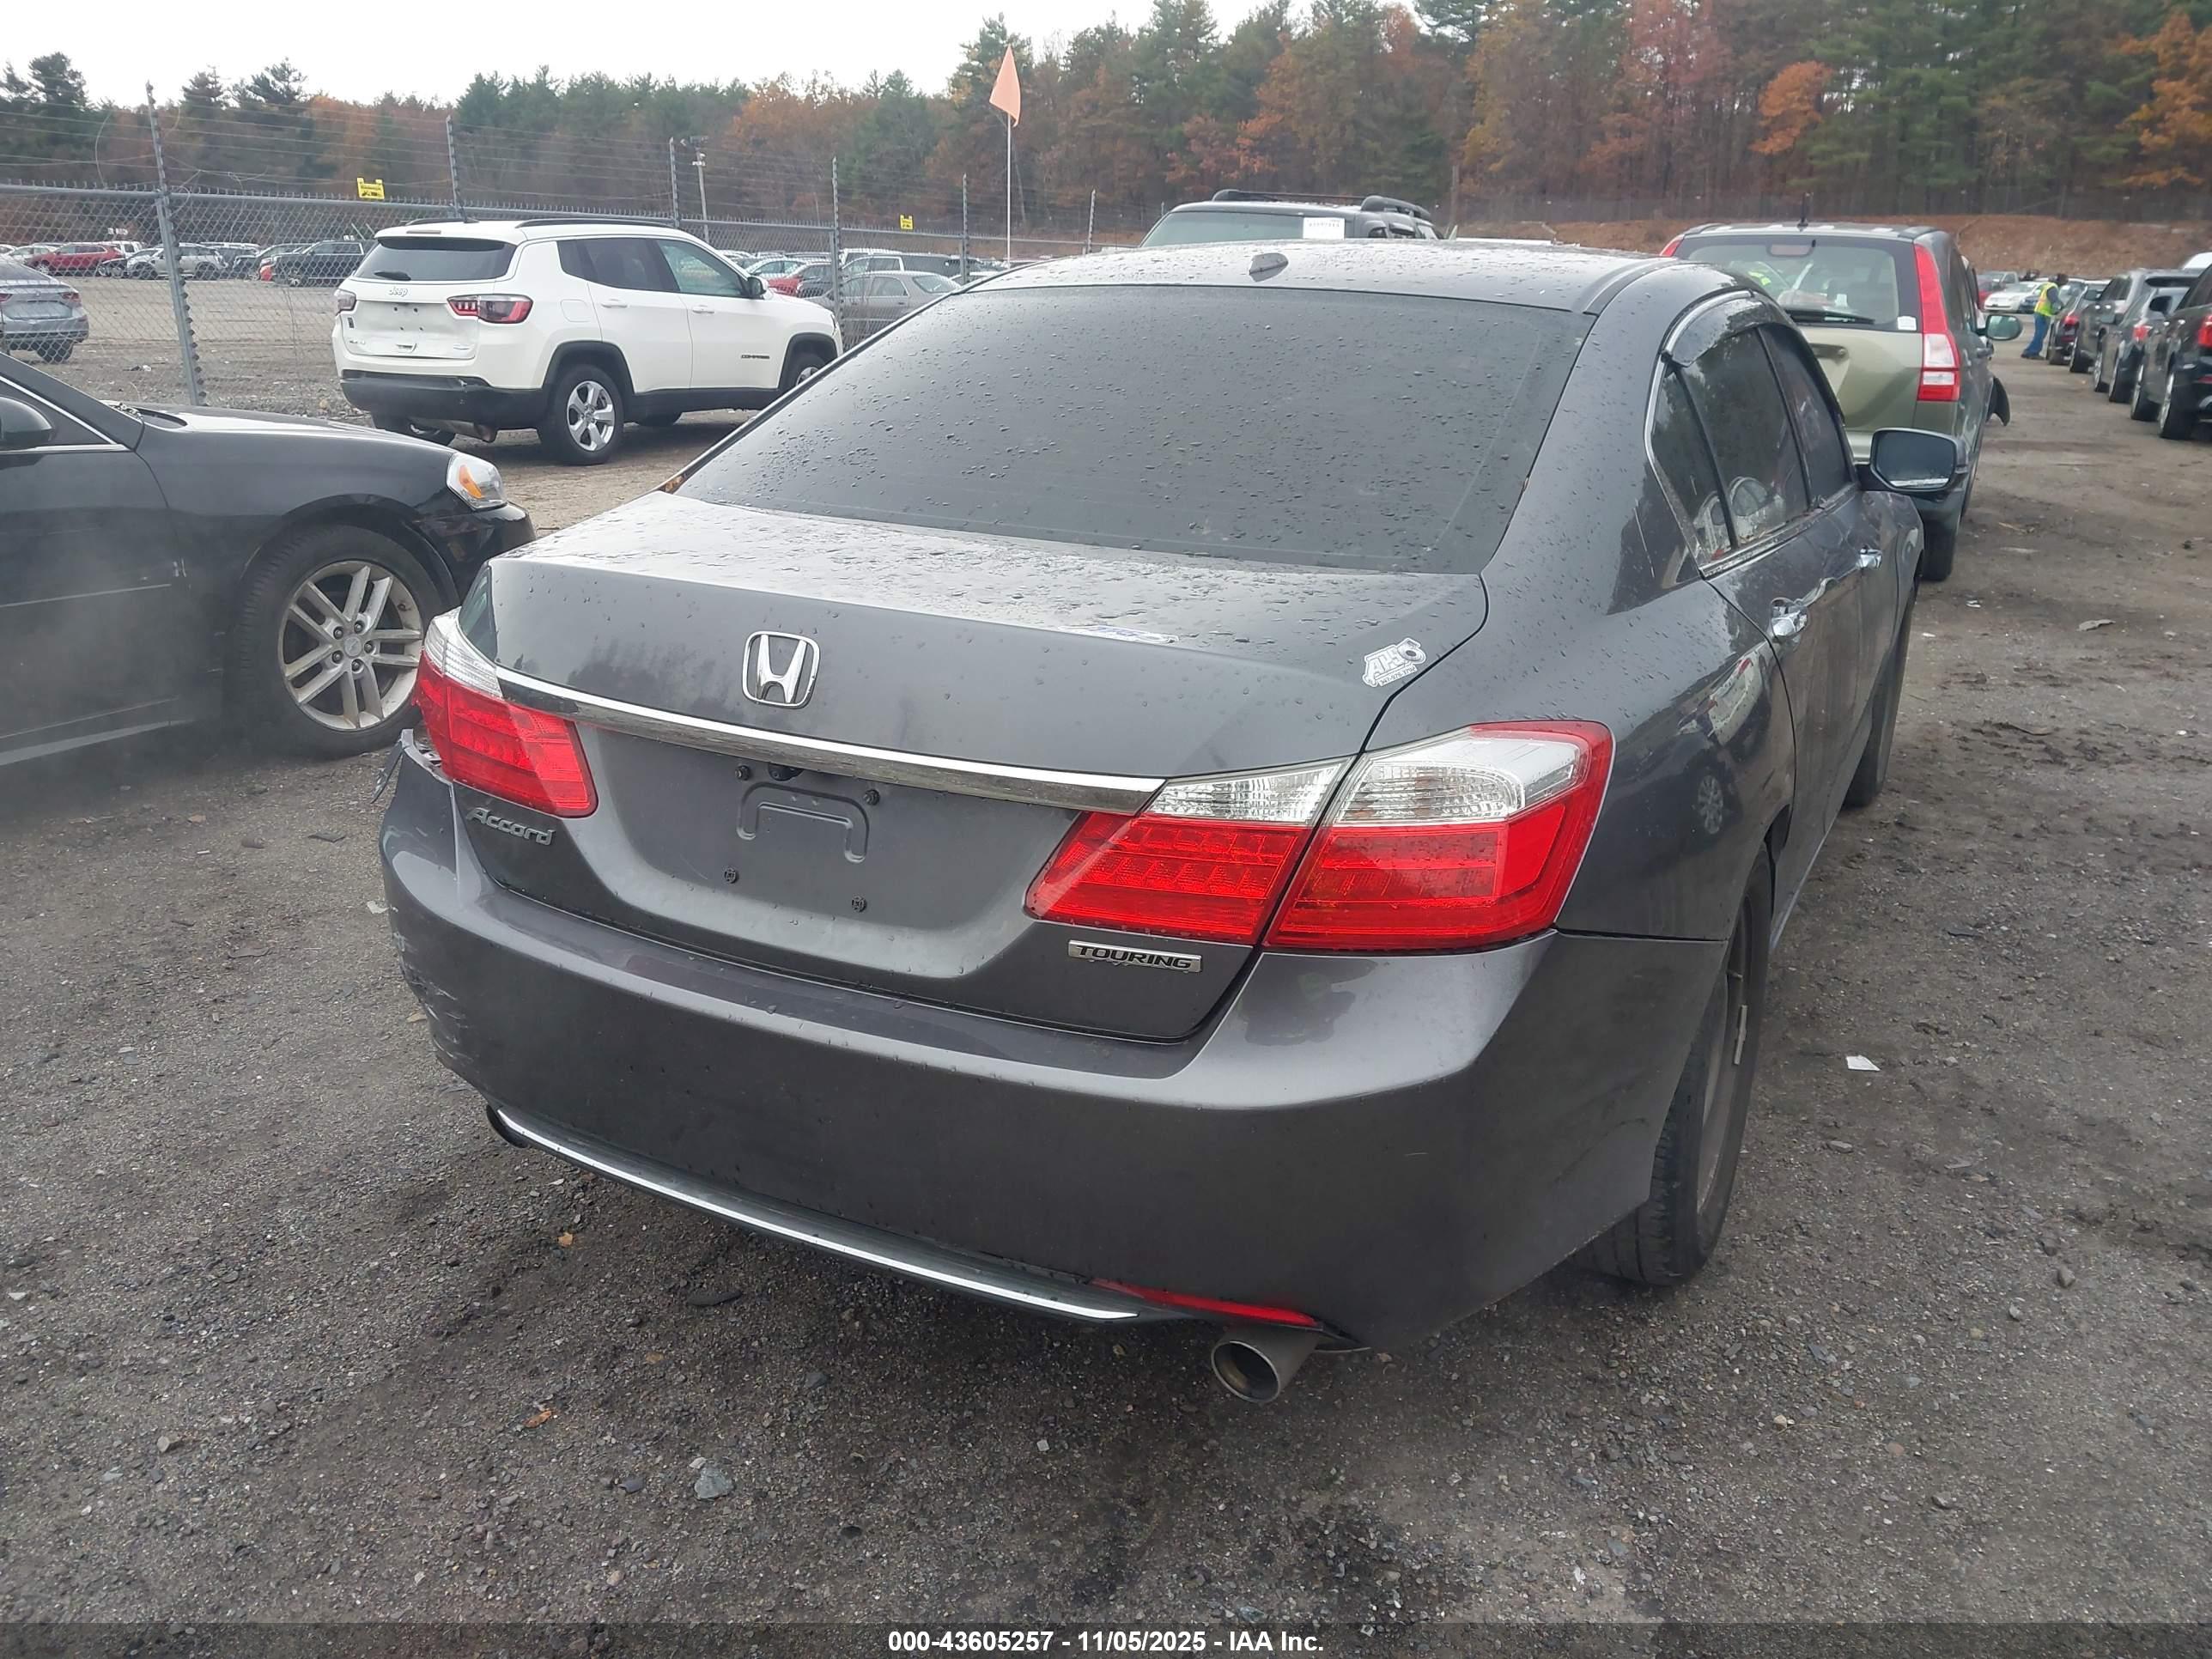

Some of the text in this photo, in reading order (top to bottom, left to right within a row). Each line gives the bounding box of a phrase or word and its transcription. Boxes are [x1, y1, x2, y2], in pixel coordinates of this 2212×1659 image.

[388, 286, 409, 298] Jeep
[466, 807, 556, 846] Accord
[1076, 945, 1193, 969] TOURING
